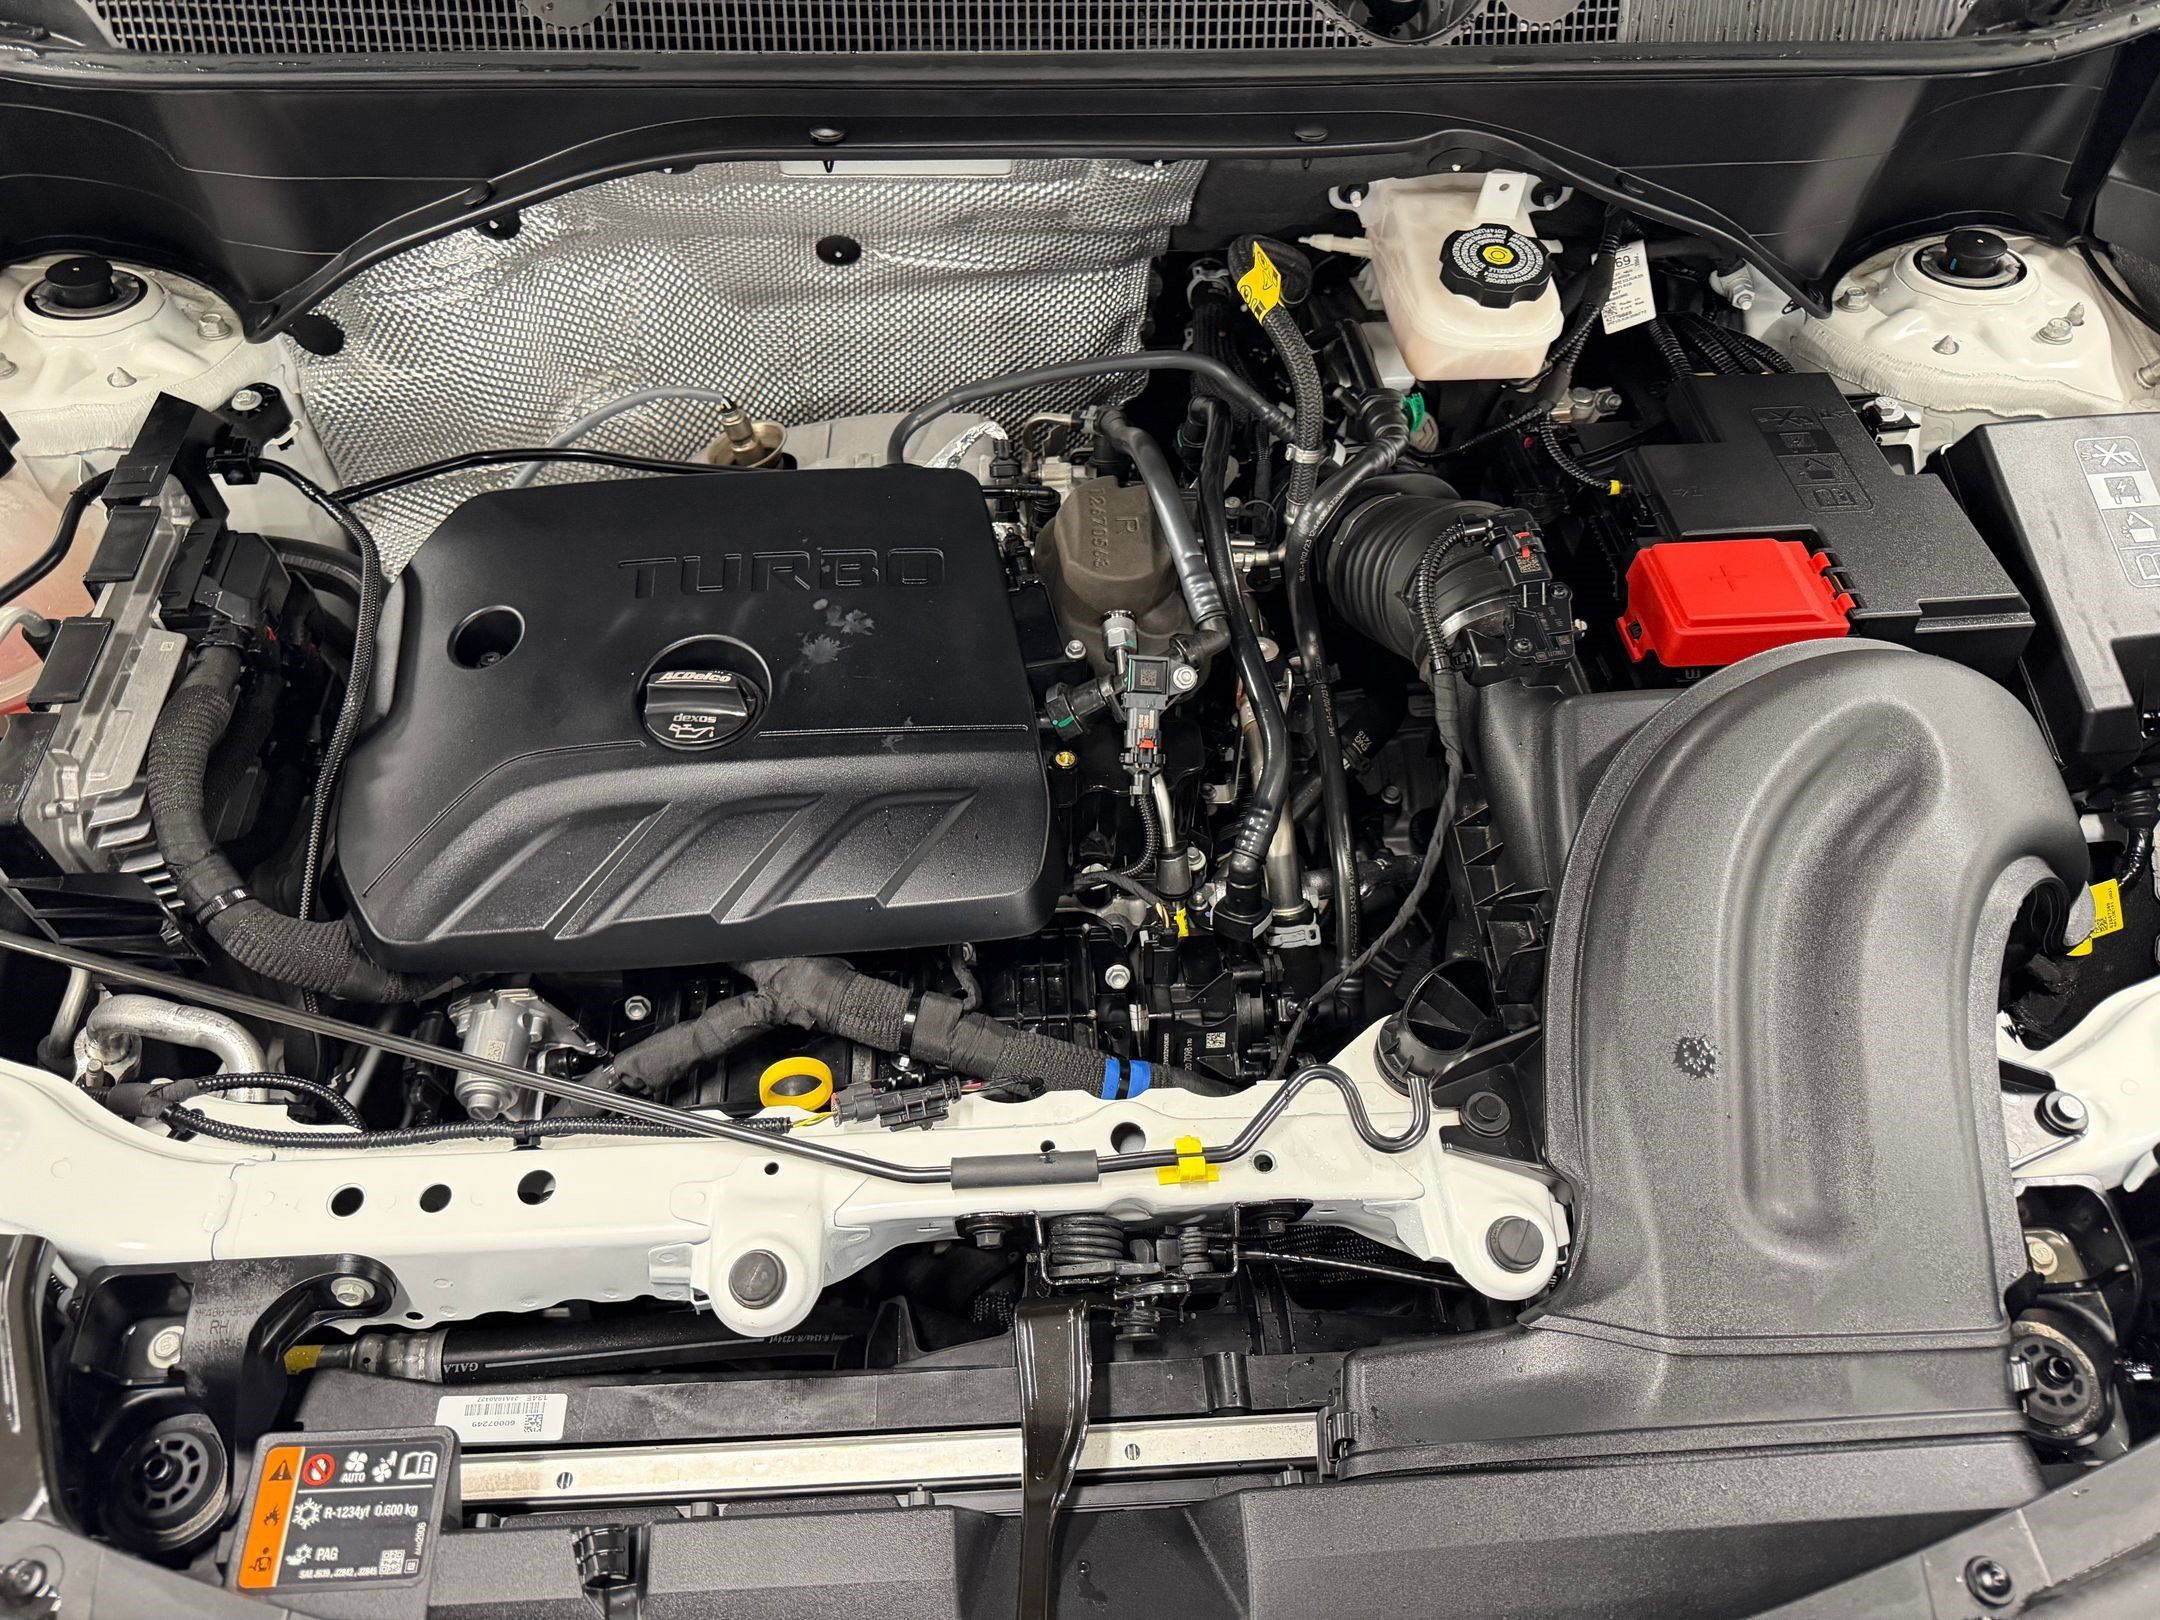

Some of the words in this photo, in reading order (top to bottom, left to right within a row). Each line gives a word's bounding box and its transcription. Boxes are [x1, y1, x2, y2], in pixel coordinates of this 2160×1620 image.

[617, 548, 945, 598] TURBO
[659, 671, 732, 682] ACDelco
[673, 713, 717, 724] dexos
[210, 1320, 229, 1335] RH
[340, 1472, 367, 1483] AUTO
[324, 1504, 371, 1520] R-1234yf
[374, 1504, 403, 1517] 0.600
[405, 1503, 418, 1517] kg
[316, 1546, 339, 1561] PAG
